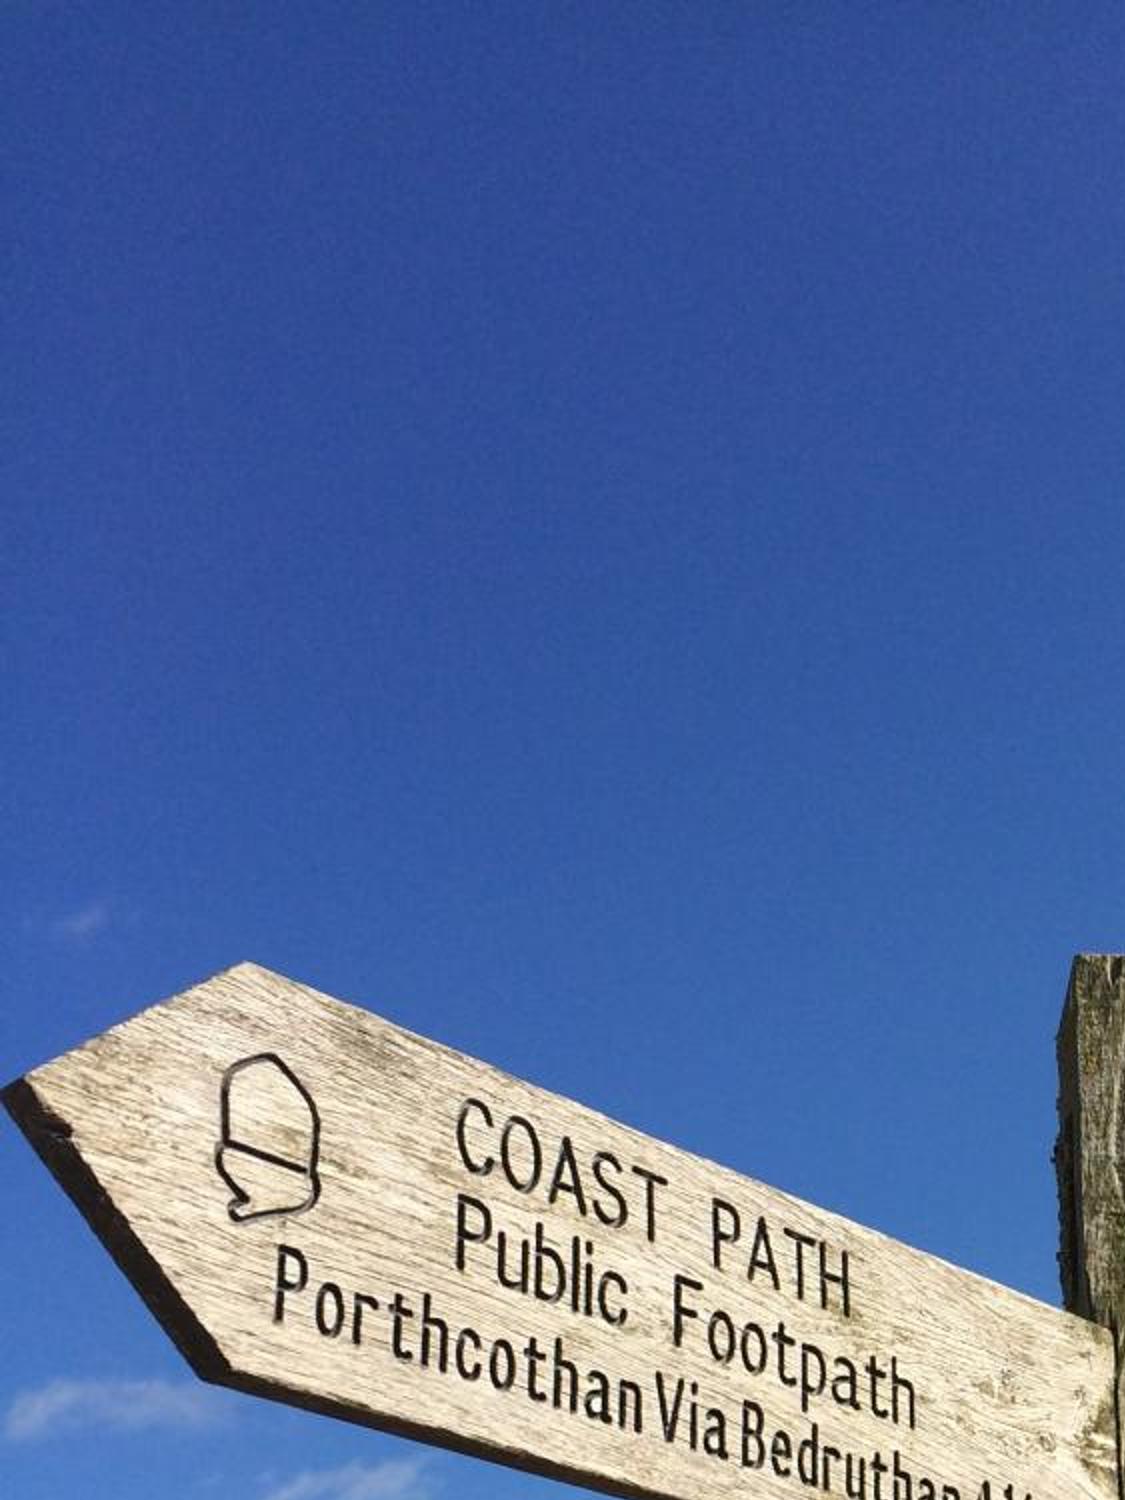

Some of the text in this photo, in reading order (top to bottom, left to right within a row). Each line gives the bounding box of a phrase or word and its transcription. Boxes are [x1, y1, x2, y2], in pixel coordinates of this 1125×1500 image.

[456, 1097, 850, 1318] COAST PATH
[456, 1193, 915, 1431] Public Footpath
[273, 1244, 642, 1433] Porthcothan
[655, 1370, 729, 1460] Via
